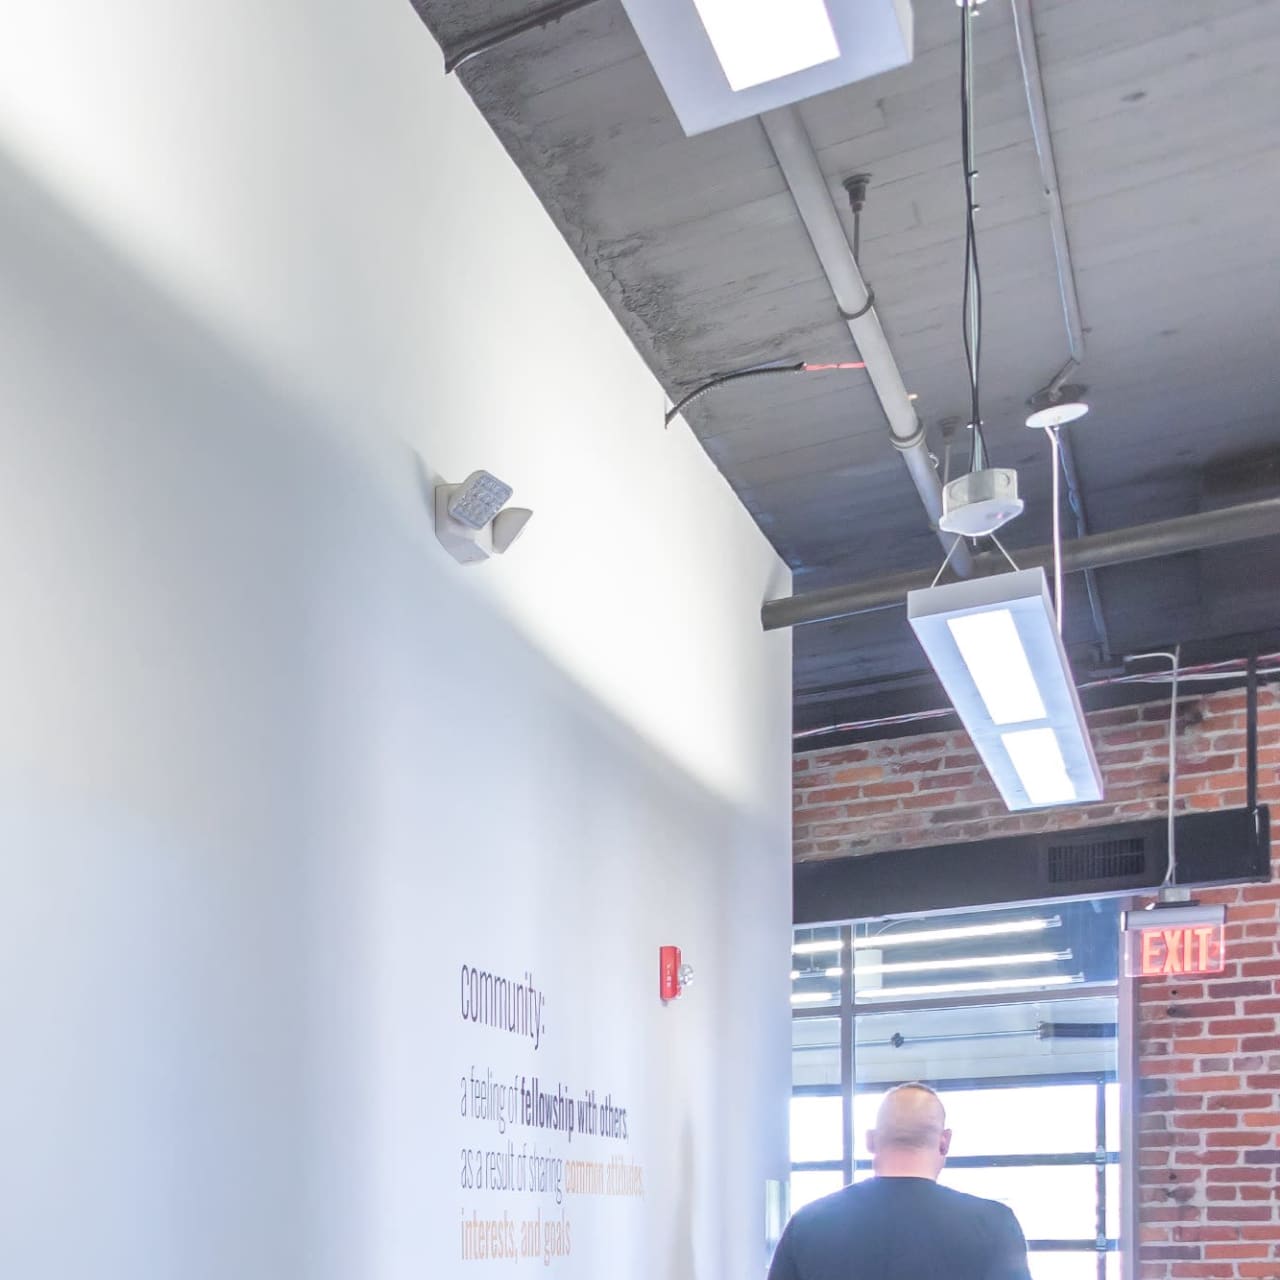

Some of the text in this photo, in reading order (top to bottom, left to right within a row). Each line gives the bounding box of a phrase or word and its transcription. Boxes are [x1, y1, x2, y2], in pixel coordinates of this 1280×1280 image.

[1142, 928, 1213, 974] EXIT
[461, 964, 545, 1050] community:
[460, 1076, 467, 1117] a
[470, 1065, 506, 1134] feeling
[508, 1075, 518, 1124] of
[520, 1076, 574, 1143] fellowship
[577, 1089, 597, 1136] with
[461, 1148, 473, 1189] as
[476, 1150, 482, 1189] a
[485, 1139, 515, 1191] result
[517, 1143, 527, 1192] of
[529, 1142, 563, 1205] sharing
[565, 1159, 604, 1194] common
[520, 1207, 541, 1257] and
[544, 1208, 571, 1266] goals
